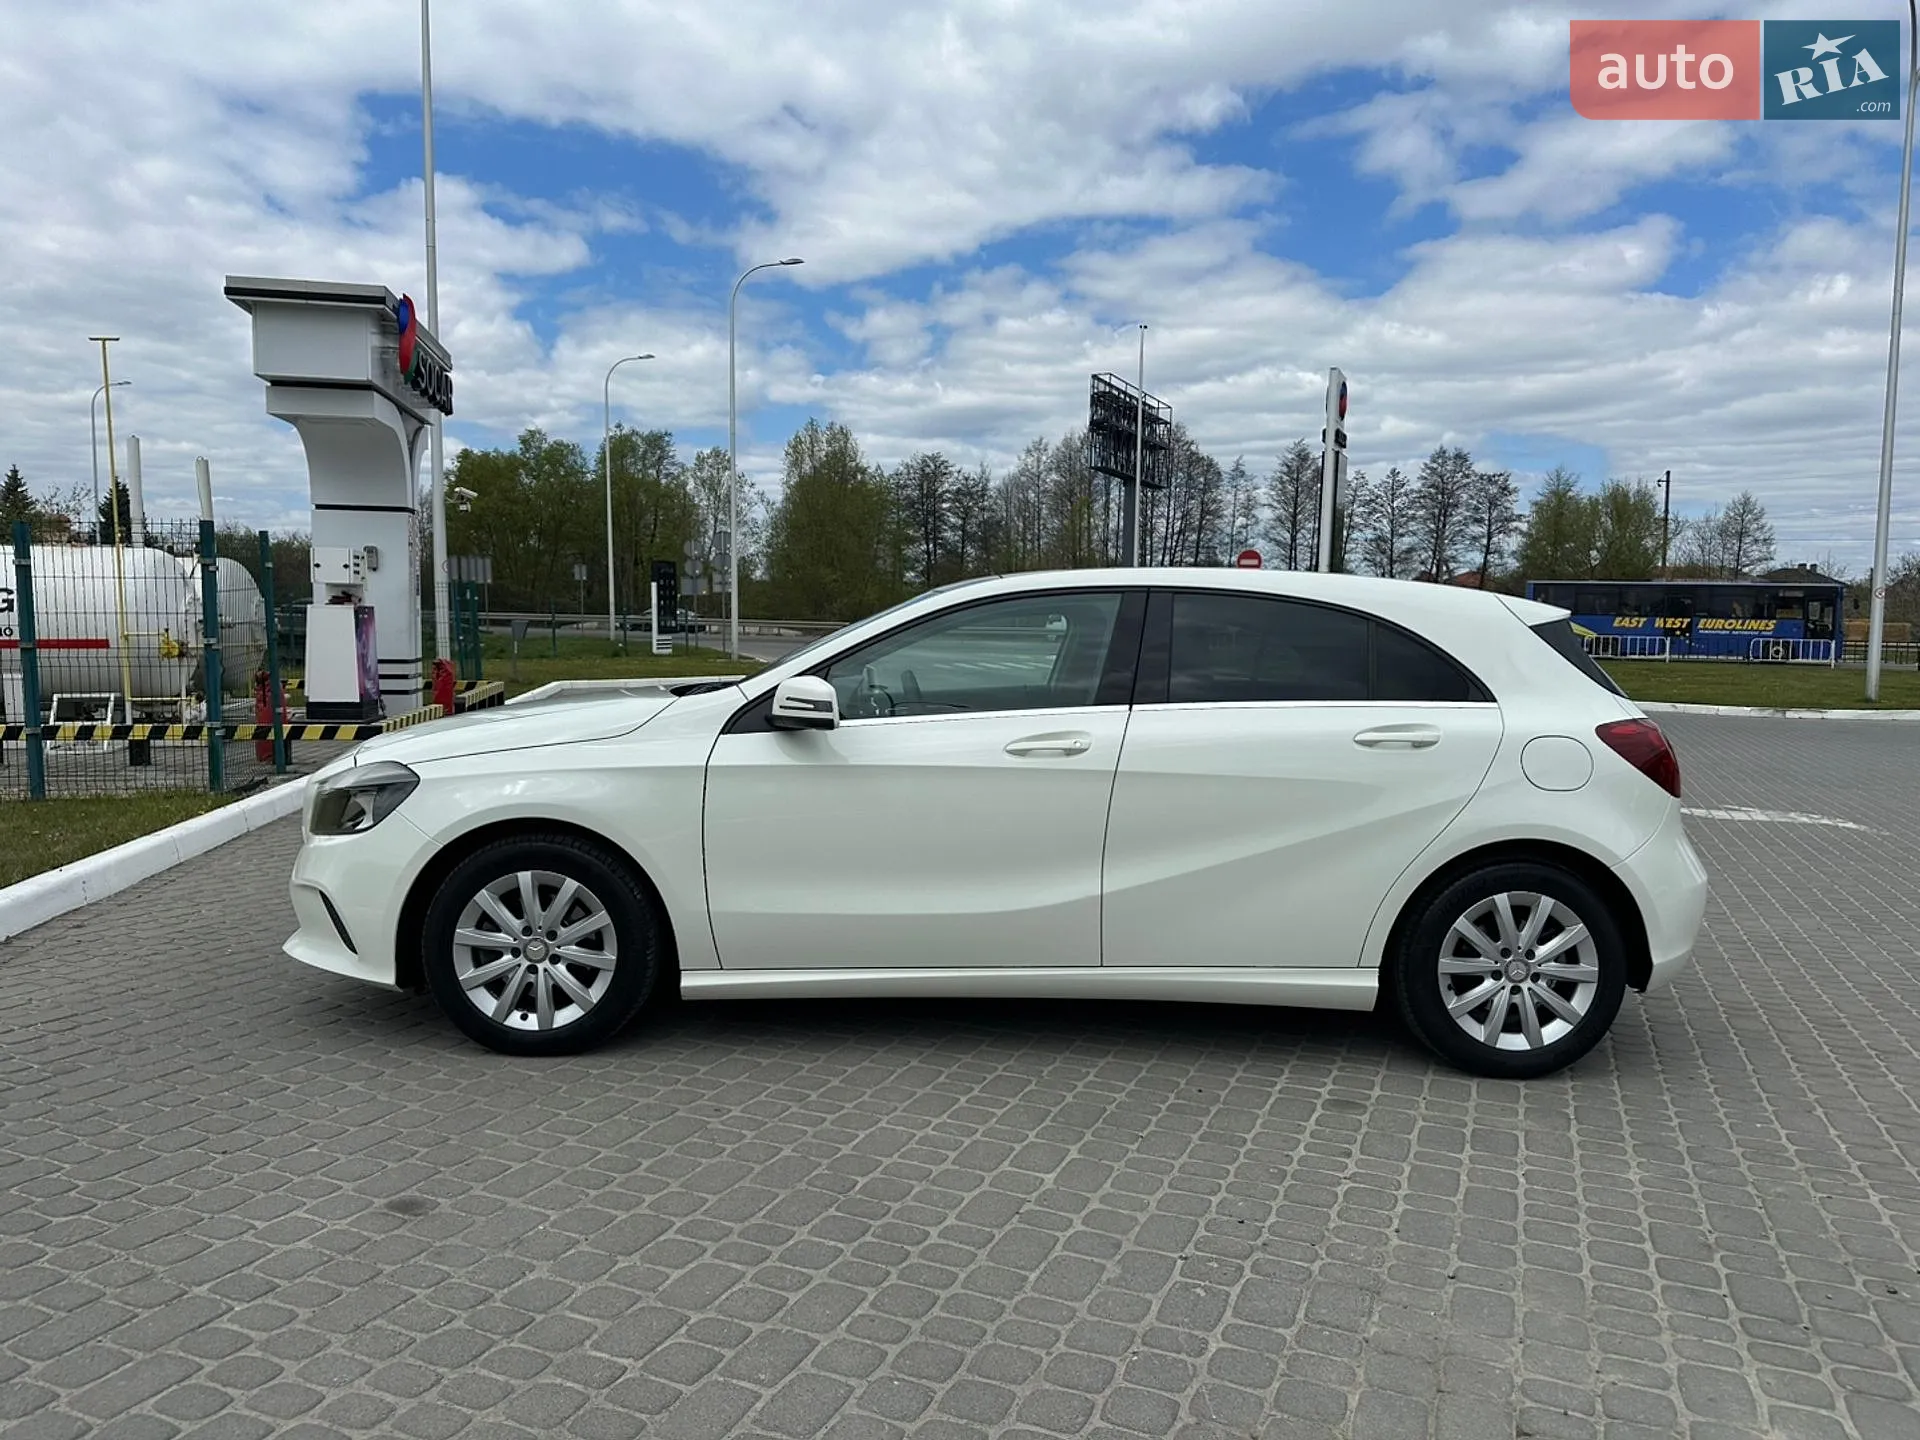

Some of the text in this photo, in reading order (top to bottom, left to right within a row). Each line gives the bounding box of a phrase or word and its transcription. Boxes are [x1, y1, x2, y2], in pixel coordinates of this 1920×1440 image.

[1612, 617, 1778, 632] EAST WEST EUROLINES
